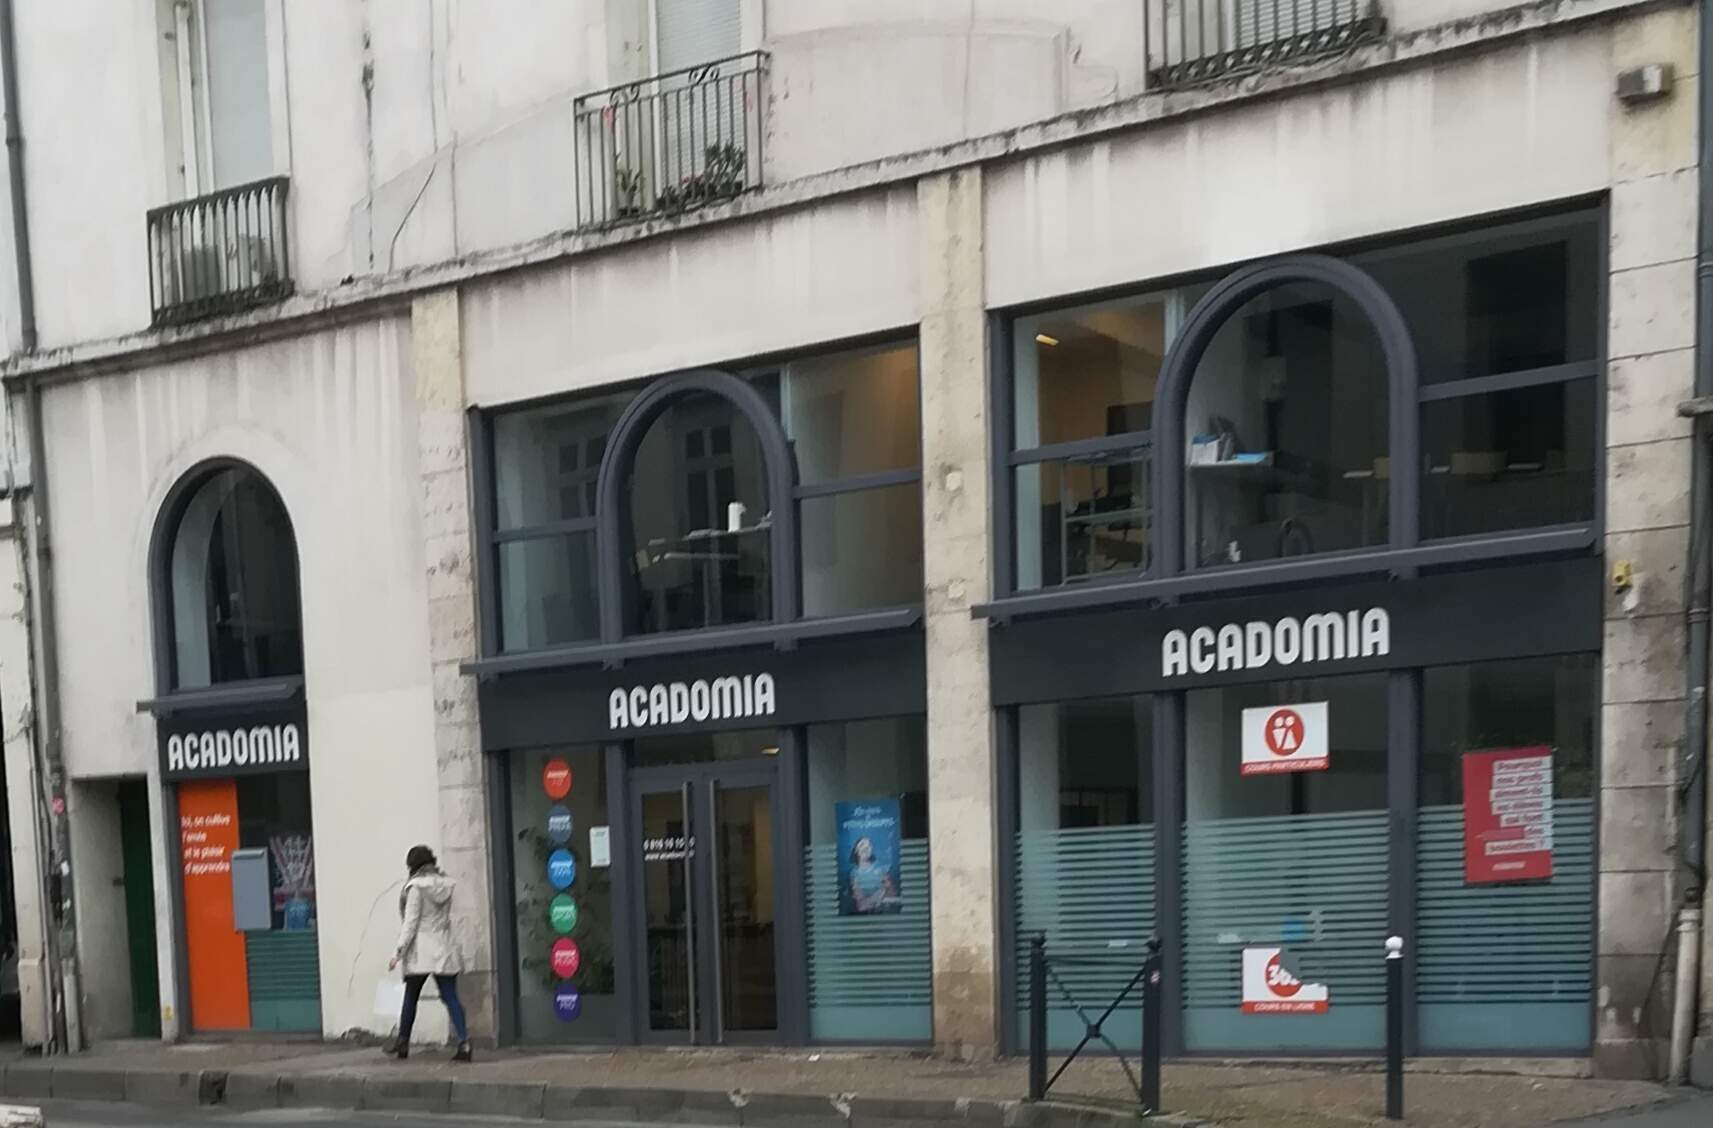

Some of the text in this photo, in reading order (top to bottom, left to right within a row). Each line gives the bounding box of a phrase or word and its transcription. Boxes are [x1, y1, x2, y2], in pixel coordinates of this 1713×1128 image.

[1162, 607, 1390, 677] ACADOMIA
[609, 672, 776, 730] ACADOMIA
[167, 723, 300, 771] ACADOMIA
